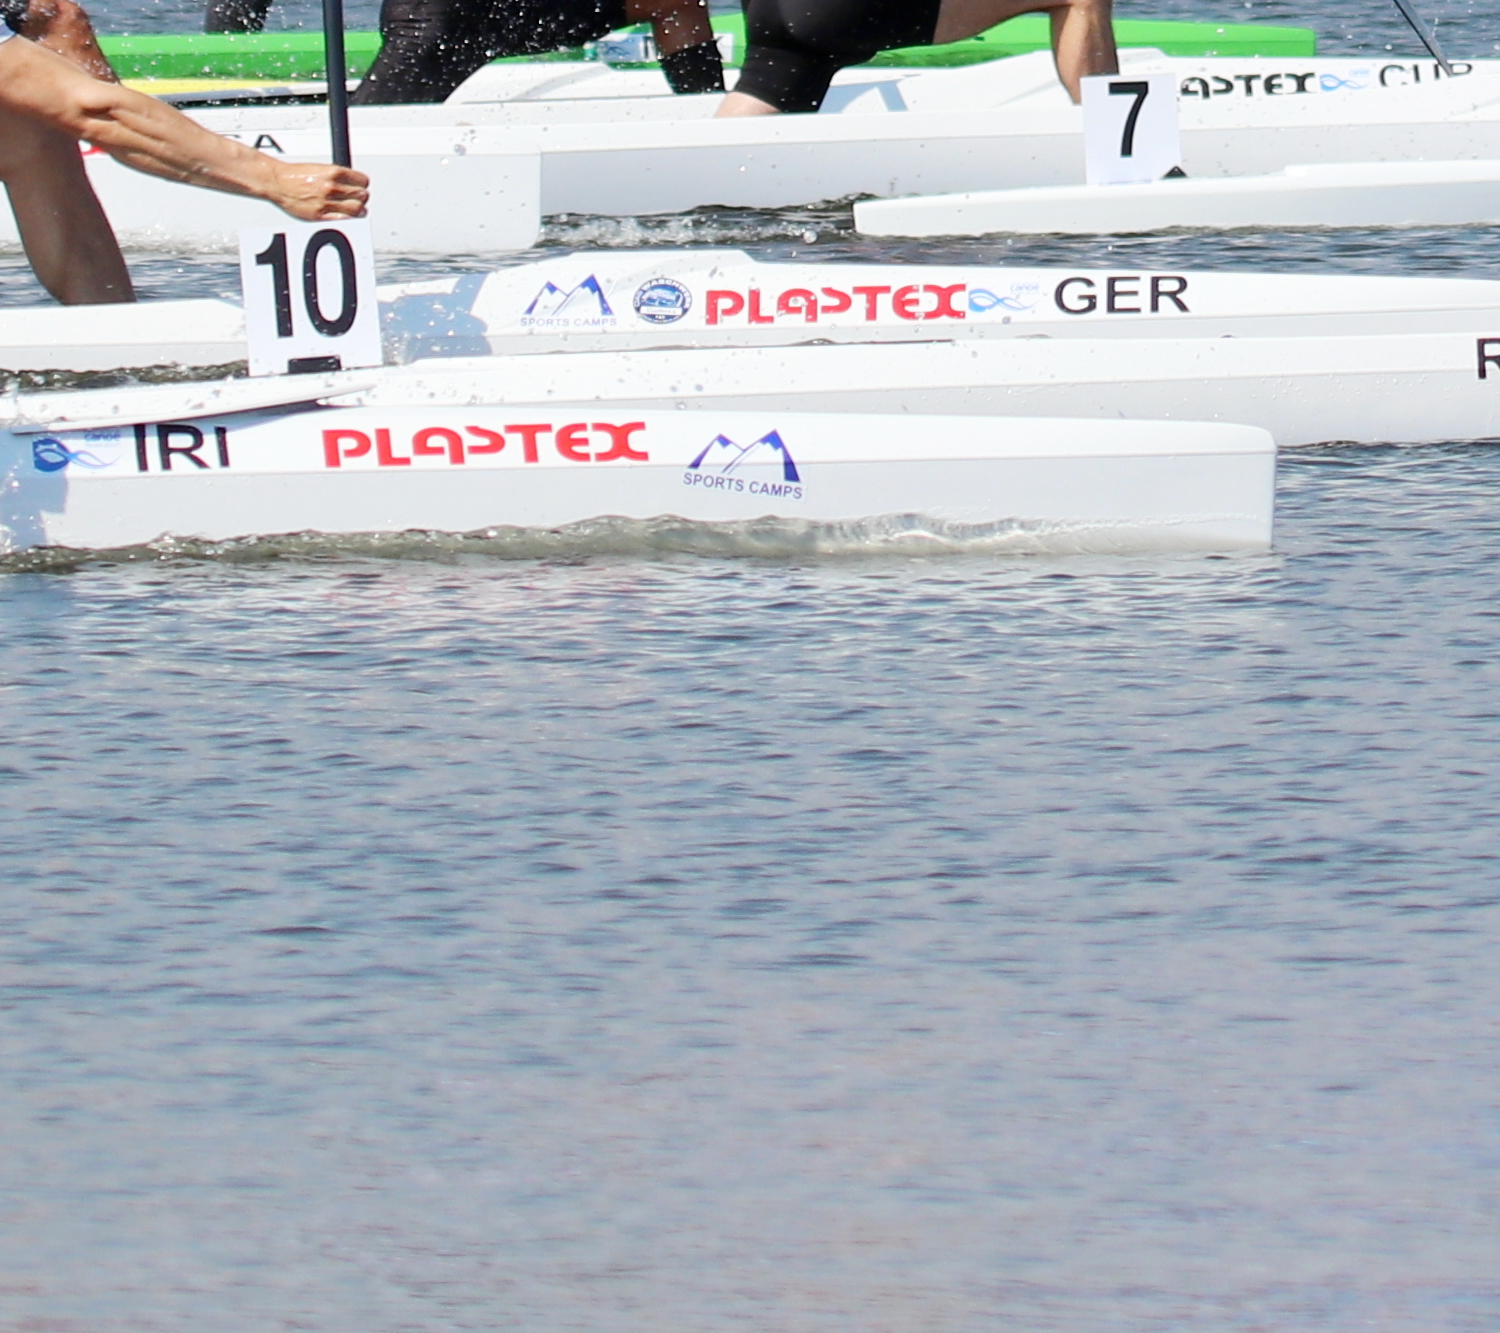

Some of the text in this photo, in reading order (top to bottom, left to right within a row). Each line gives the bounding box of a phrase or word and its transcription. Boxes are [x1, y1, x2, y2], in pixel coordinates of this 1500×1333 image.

[1180, 71, 1316, 99] ASTEX
[1107, 81, 1150, 159] 7
[254, 228, 358, 338] 10
[705, 283, 966, 326] PLASTEX
[1055, 275, 1190, 316] GER
[519, 316, 618, 328] SPORTS CAMPS
[133, 423, 230, 473] IRI
[322, 421, 650, 469] PLASTEX
[682, 471, 804, 501] SPORTS CAMPS
